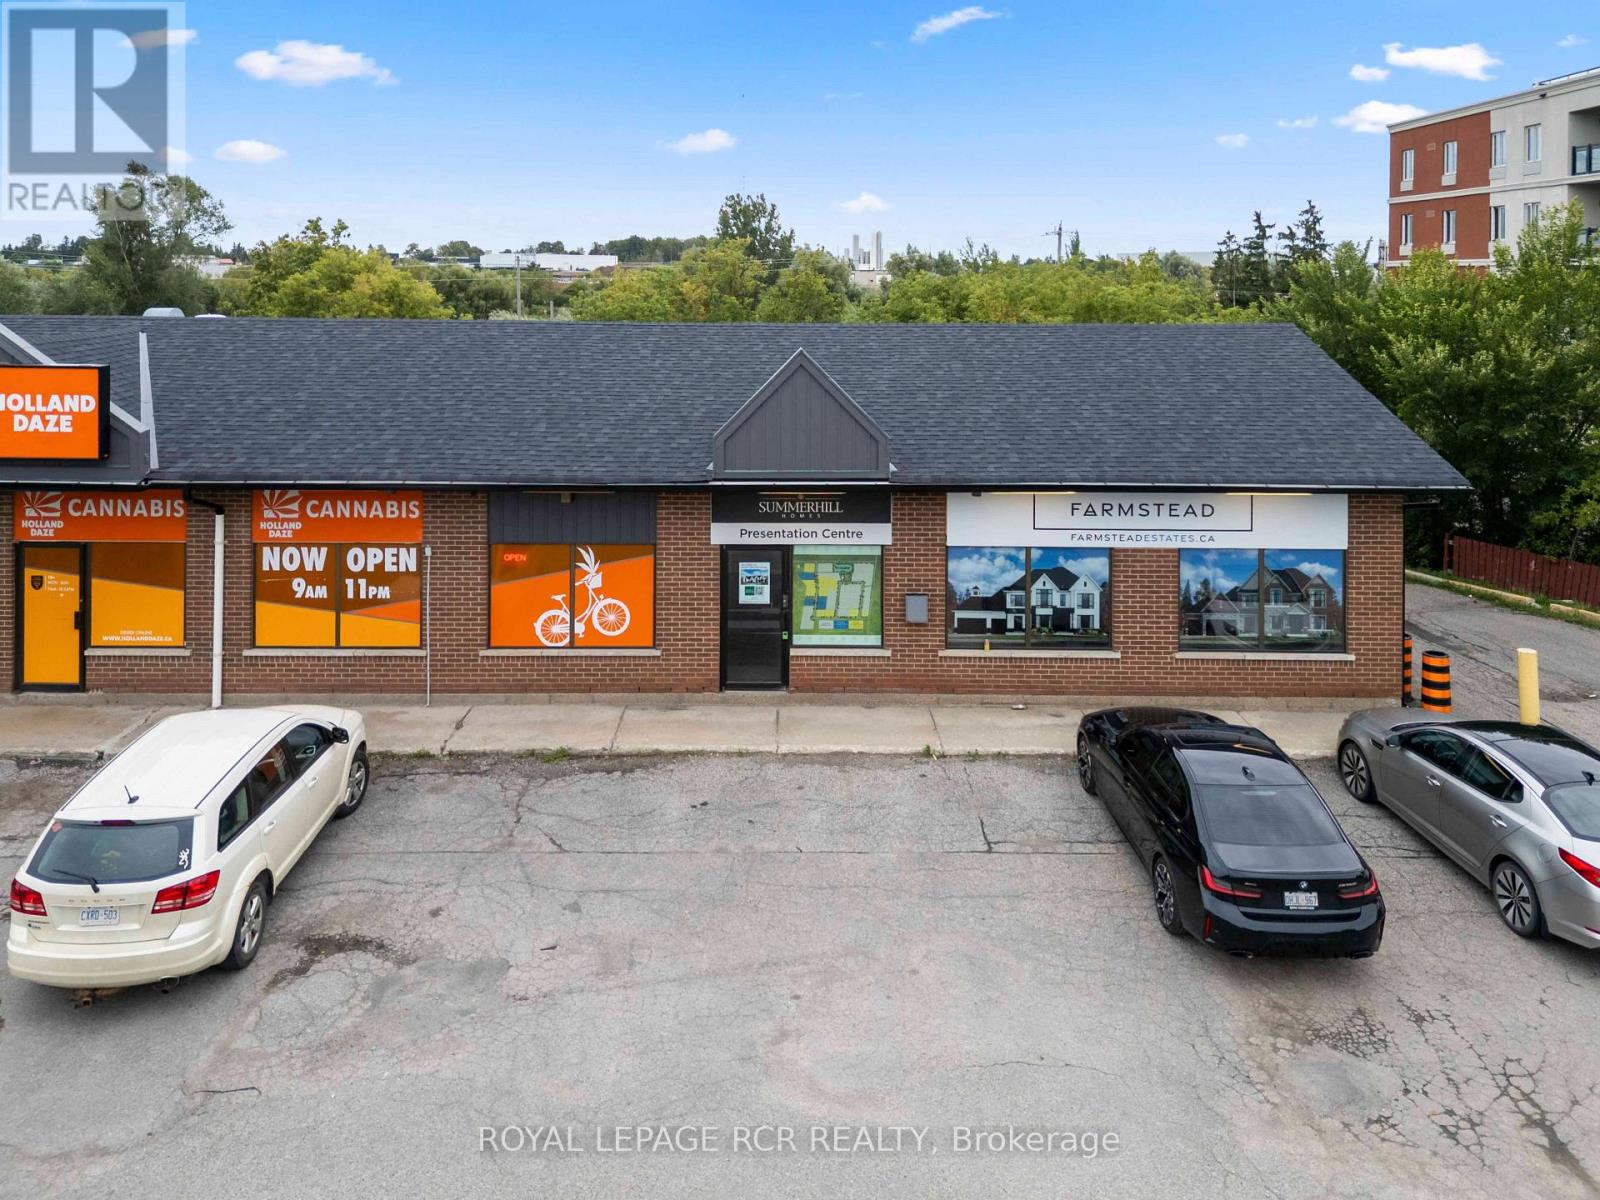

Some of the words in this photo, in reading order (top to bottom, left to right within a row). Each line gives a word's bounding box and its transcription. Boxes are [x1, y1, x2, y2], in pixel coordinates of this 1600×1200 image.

[13, 414, 73, 432] DAZE
[67, 498, 185, 518] CANNABIS
[306, 500, 420, 519] CANNABIS
[758, 501, 844, 513] SUMMERHILL
[1071, 502, 1215, 518] FARMSTEAD
[21, 520, 64, 528] HOLLAND
[260, 521, 302, 530] HOLLAND
[30, 528, 55, 536] DAZE
[268, 530, 293, 538] DAZE
[740, 528, 818, 539] Presentation
[822, 528, 864, 539] Centre
[1071, 533, 1216, 543] FARMSTEADESTATES.CA
[262, 546, 328, 572] NOW
[346, 547, 417, 572] OPEN
[503, 553, 527, 562] OPEN
[291, 577, 328, 599] 9AM
[345, 578, 391, 599] 11PM
